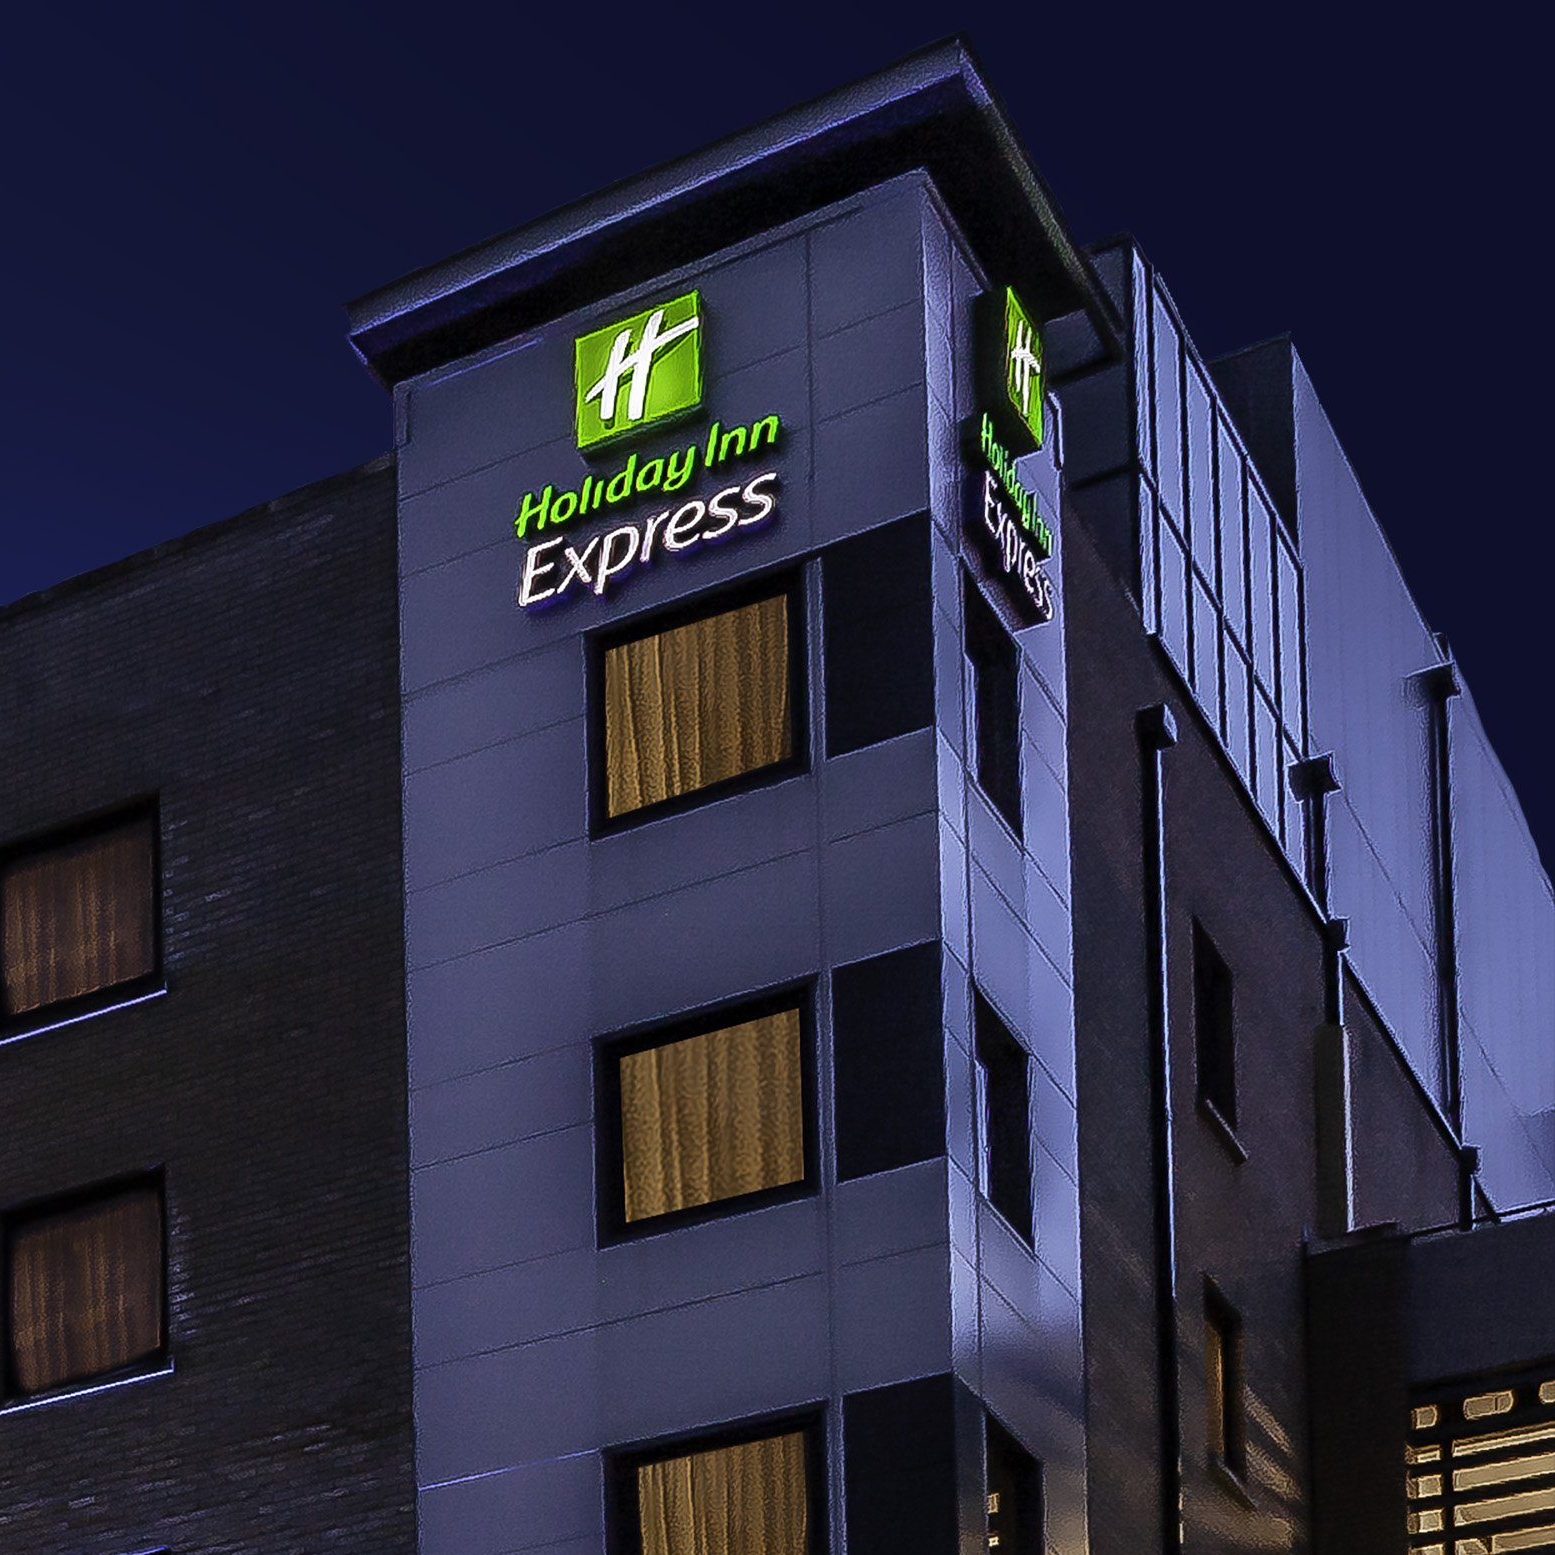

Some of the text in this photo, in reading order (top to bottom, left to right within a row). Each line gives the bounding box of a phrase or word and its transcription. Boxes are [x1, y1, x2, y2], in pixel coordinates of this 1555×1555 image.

[513, 415, 780, 539] Holiday Inn
[517, 472, 778, 607] Express
[981, 411, 1053, 557] Holiday Inn
[983, 468, 1053, 619] Express
